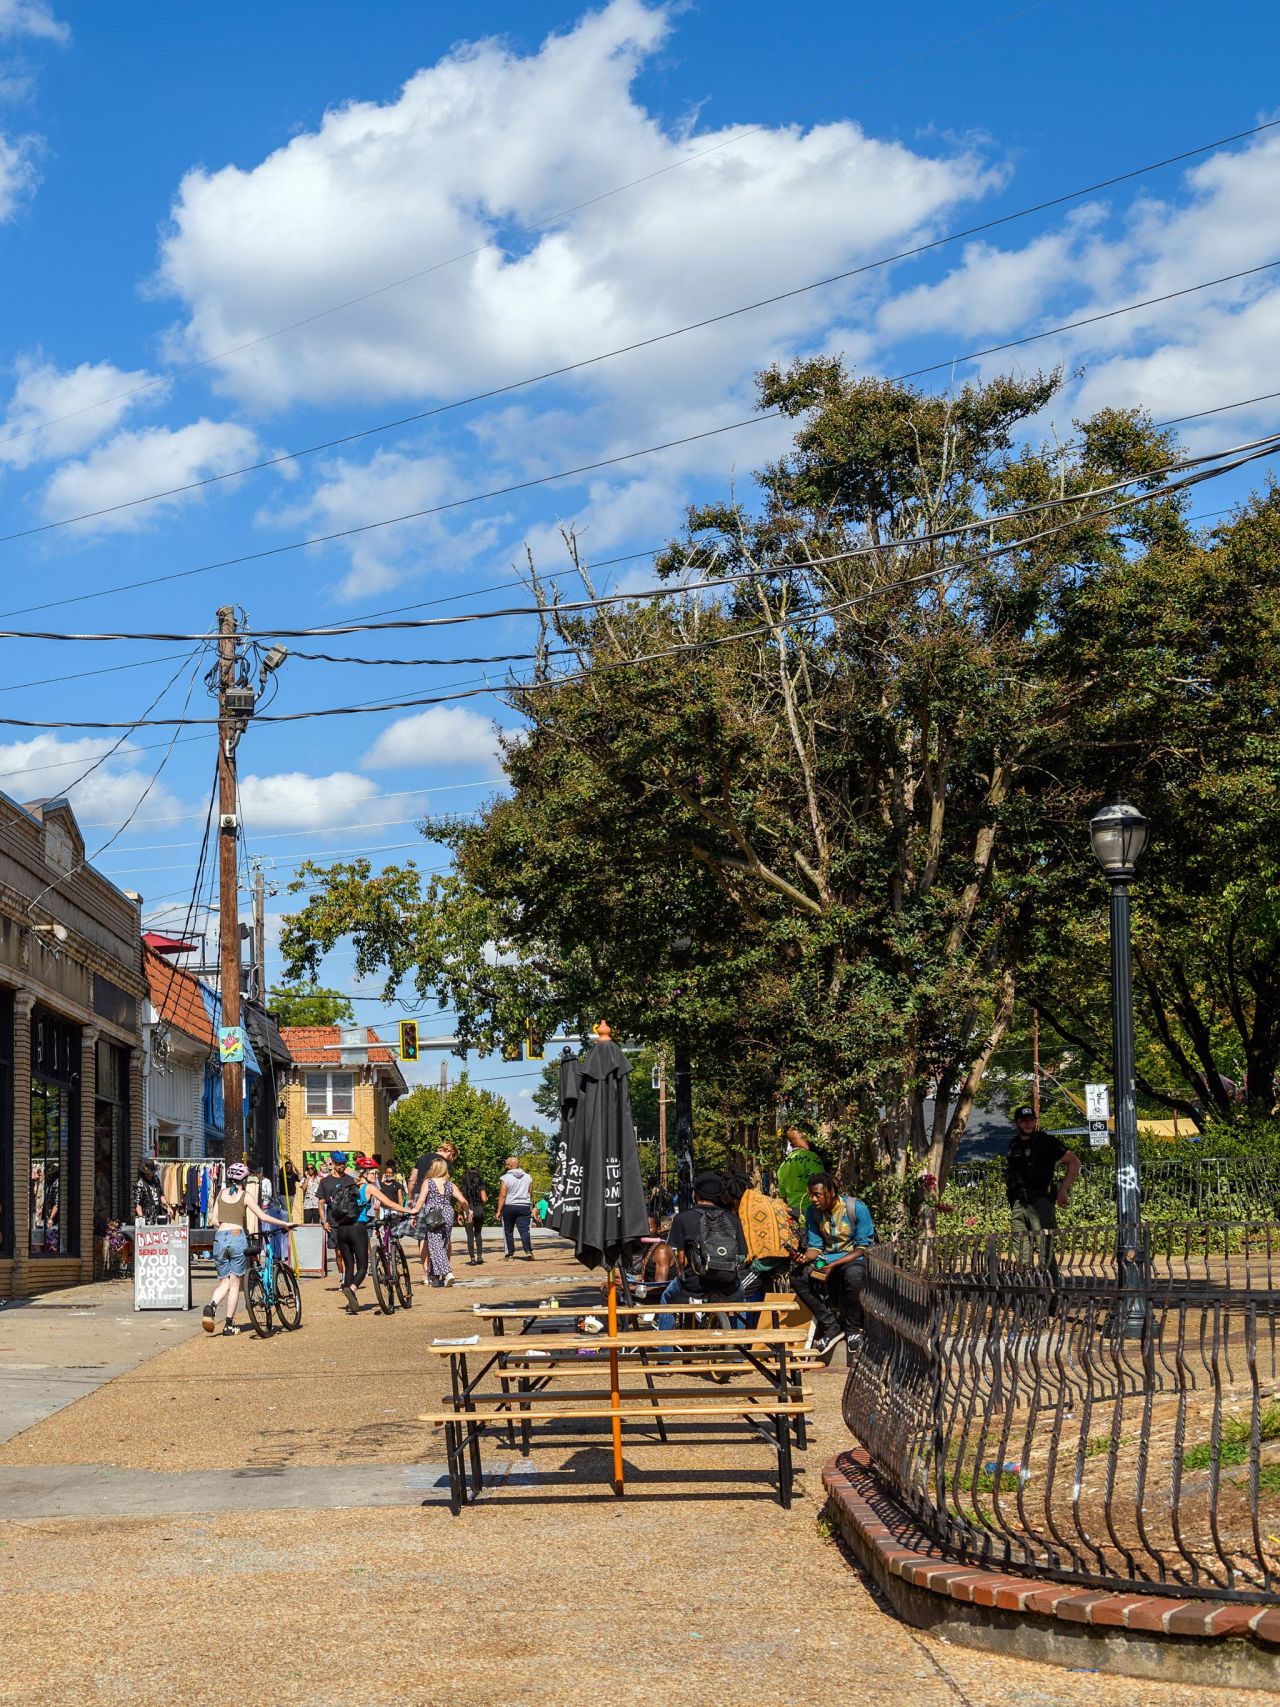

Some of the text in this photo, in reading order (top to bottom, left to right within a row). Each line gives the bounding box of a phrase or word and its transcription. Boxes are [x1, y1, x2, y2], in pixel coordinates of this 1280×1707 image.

[139, 1255, 178, 1266] YOUR
[139, 1277, 178, 1288] LOGO
[138, 1288, 164, 1300] ART
